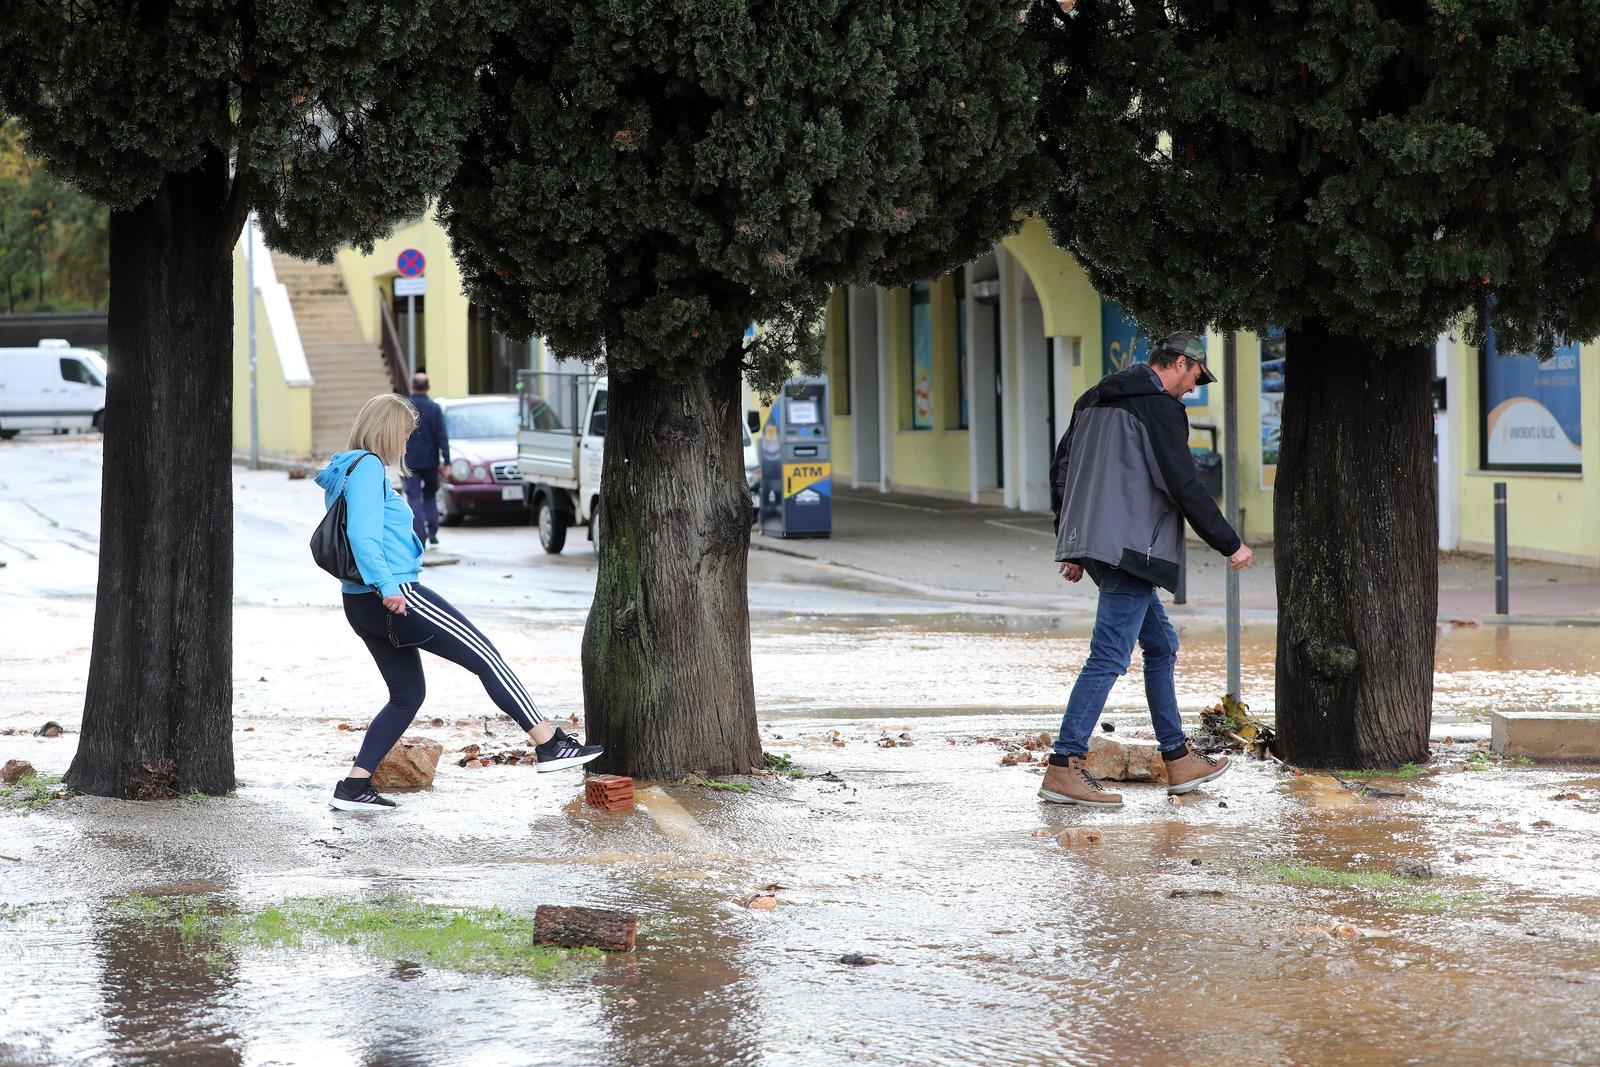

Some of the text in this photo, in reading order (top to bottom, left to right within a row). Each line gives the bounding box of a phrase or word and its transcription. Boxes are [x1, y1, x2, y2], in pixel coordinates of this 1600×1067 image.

[1509, 426, 1536, 440] APARTMENTS
[1541, 426, 1556, 440] VILLAS
[792, 466, 823, 478] ATM
